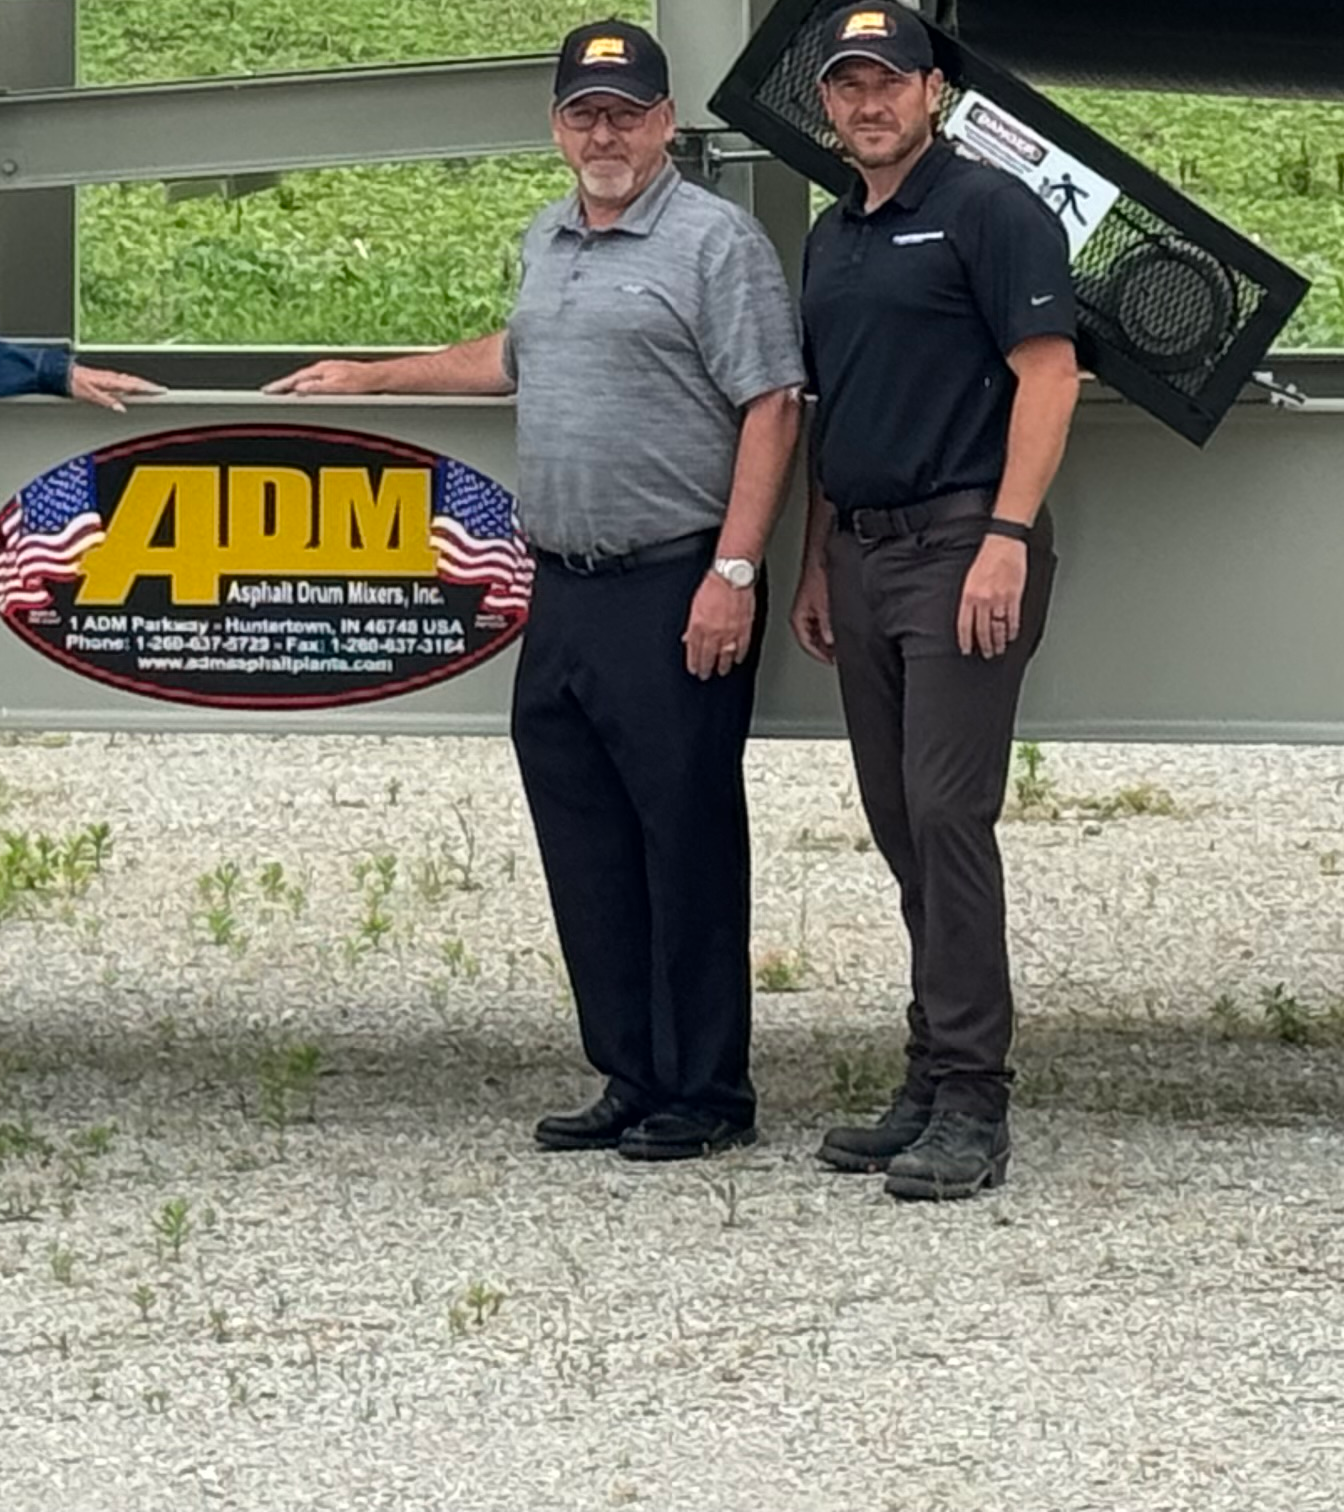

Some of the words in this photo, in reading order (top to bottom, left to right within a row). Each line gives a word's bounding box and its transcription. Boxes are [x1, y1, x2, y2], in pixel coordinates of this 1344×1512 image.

[74, 465, 440, 606] ADM
[227, 580, 293, 608] Asphalt
[297, 581, 344, 604] Drum
[347, 581, 409, 608] Mixers,
[413, 582, 445, 605] Inc.
[69, 616, 78, 631] 1
[83, 616, 127, 631] ADM
[131, 616, 209, 635] Parkway
[340, 619, 360, 634] IN
[422, 619, 465, 635] USA
[65, 633, 130, 651] Phone:
[286, 637, 326, 653] Fax:
